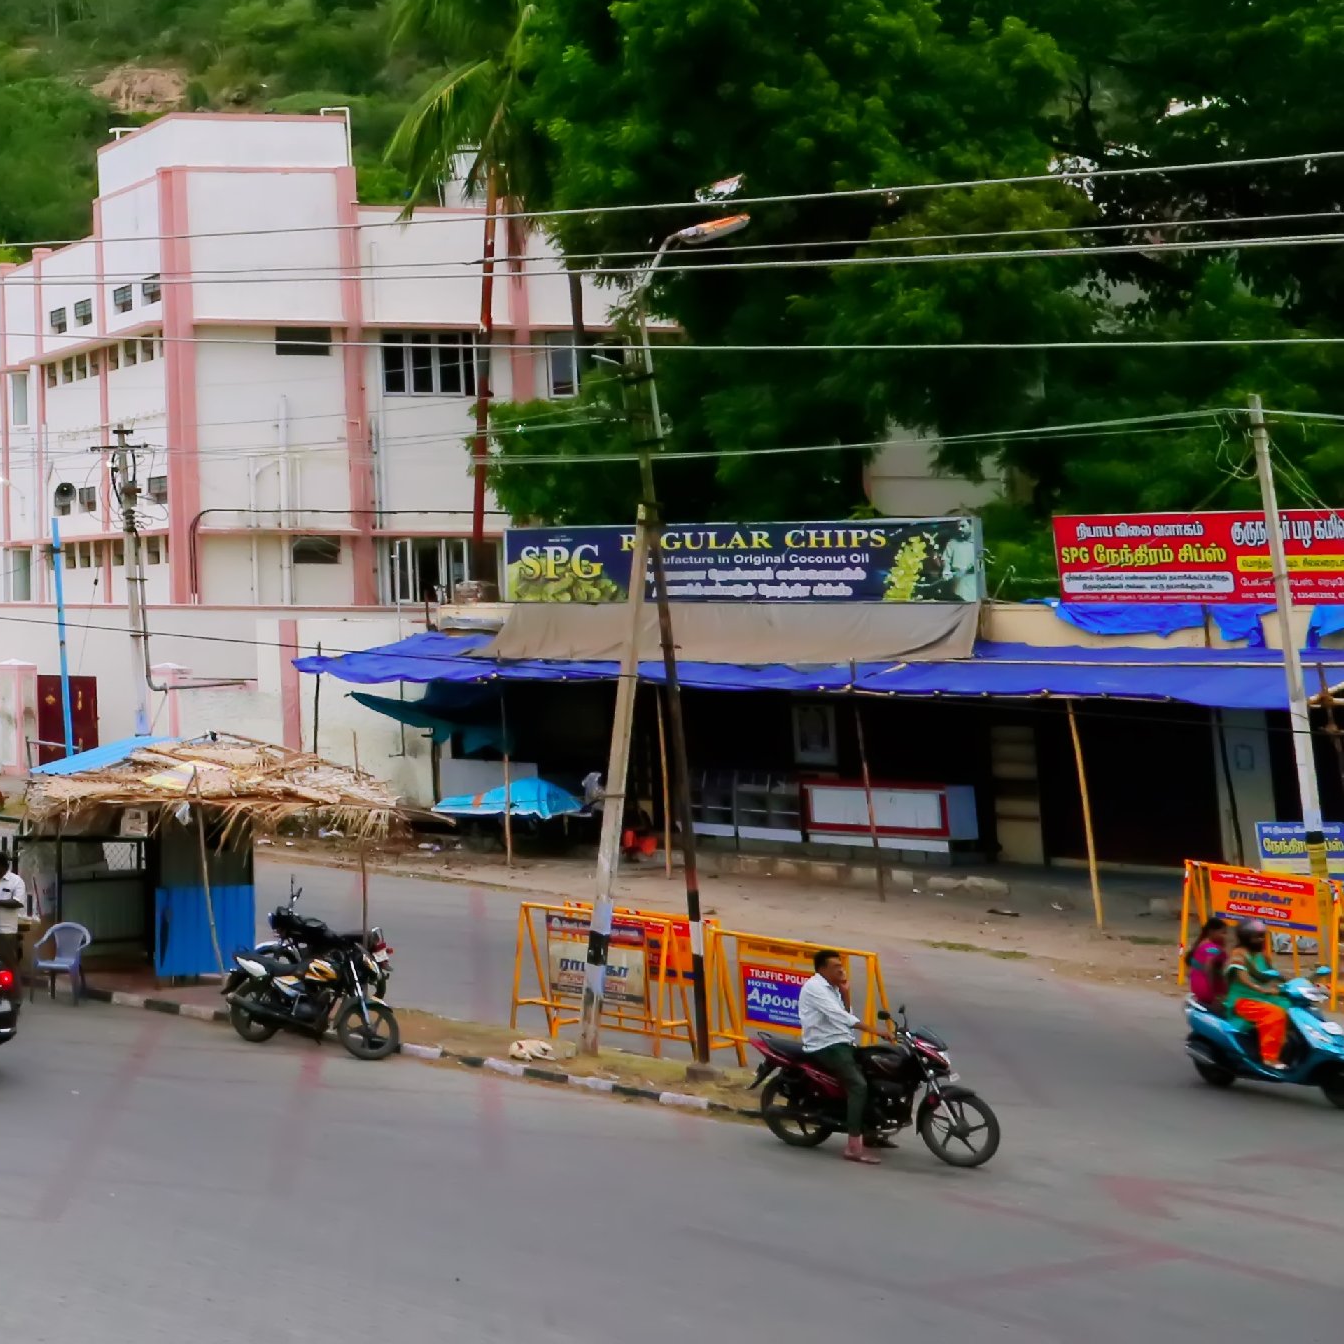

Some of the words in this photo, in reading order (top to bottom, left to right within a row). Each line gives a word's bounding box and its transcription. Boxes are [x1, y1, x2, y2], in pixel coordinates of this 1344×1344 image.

[620, 531, 773, 552] RGULAR
[784, 528, 887, 549] CHIPS
[520, 544, 604, 580] SPG
[718, 555, 729, 564] in
[733, 553, 786, 566] Original
[789, 553, 847, 564] Coconut
[849, 552, 870, 564] Oil
[1061, 547, 1090, 564] SPG
[747, 979, 779, 991] HOTEL
[749, 968, 784, 982] TRAFFIC
[785, 975, 810, 986] POLI
[747, 986, 800, 1010] Apoor
